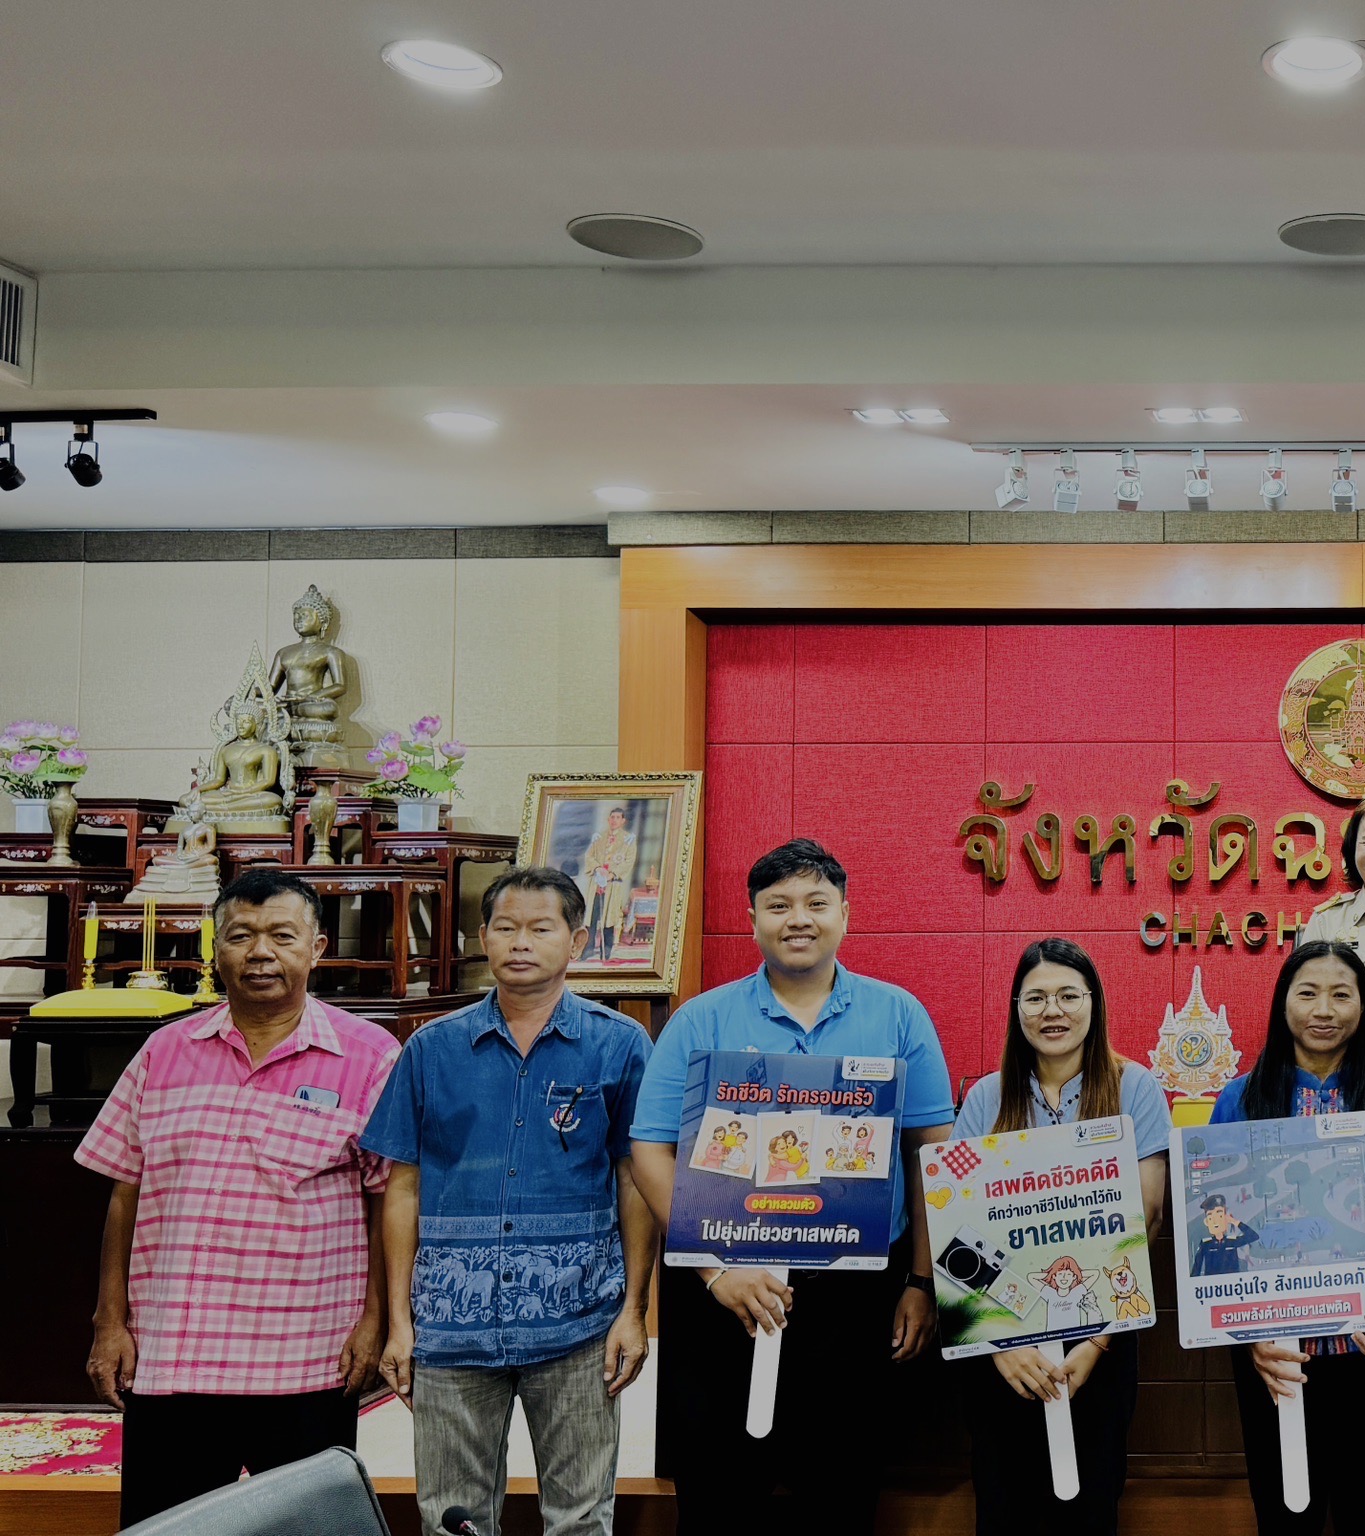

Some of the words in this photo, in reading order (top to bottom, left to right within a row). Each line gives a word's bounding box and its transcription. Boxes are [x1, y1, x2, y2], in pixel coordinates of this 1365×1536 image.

[716, 1081, 772, 1103] รักชีวิต
[776, 1083, 874, 1107] รักครอบครัว
[985, 1156, 1120, 1198] เสพติดชีวิตดีดี
[751, 1196, 816, 1211] อย่าหลวมตัว
[987, 1188, 1122, 1222] ดีกว่าเอาชีวีไปฝากไว้กับ
[701, 1216, 860, 1247] ไปยุ่งเกี่ยวยาเสพติด
[1008, 1209, 1126, 1250] ยาเสพติด
[1195, 1276, 1268, 1305] ชุมชนอุ่นใจ
[1221, 1300, 1352, 1324] รวมพลังต้านภัยยาเสพติด
